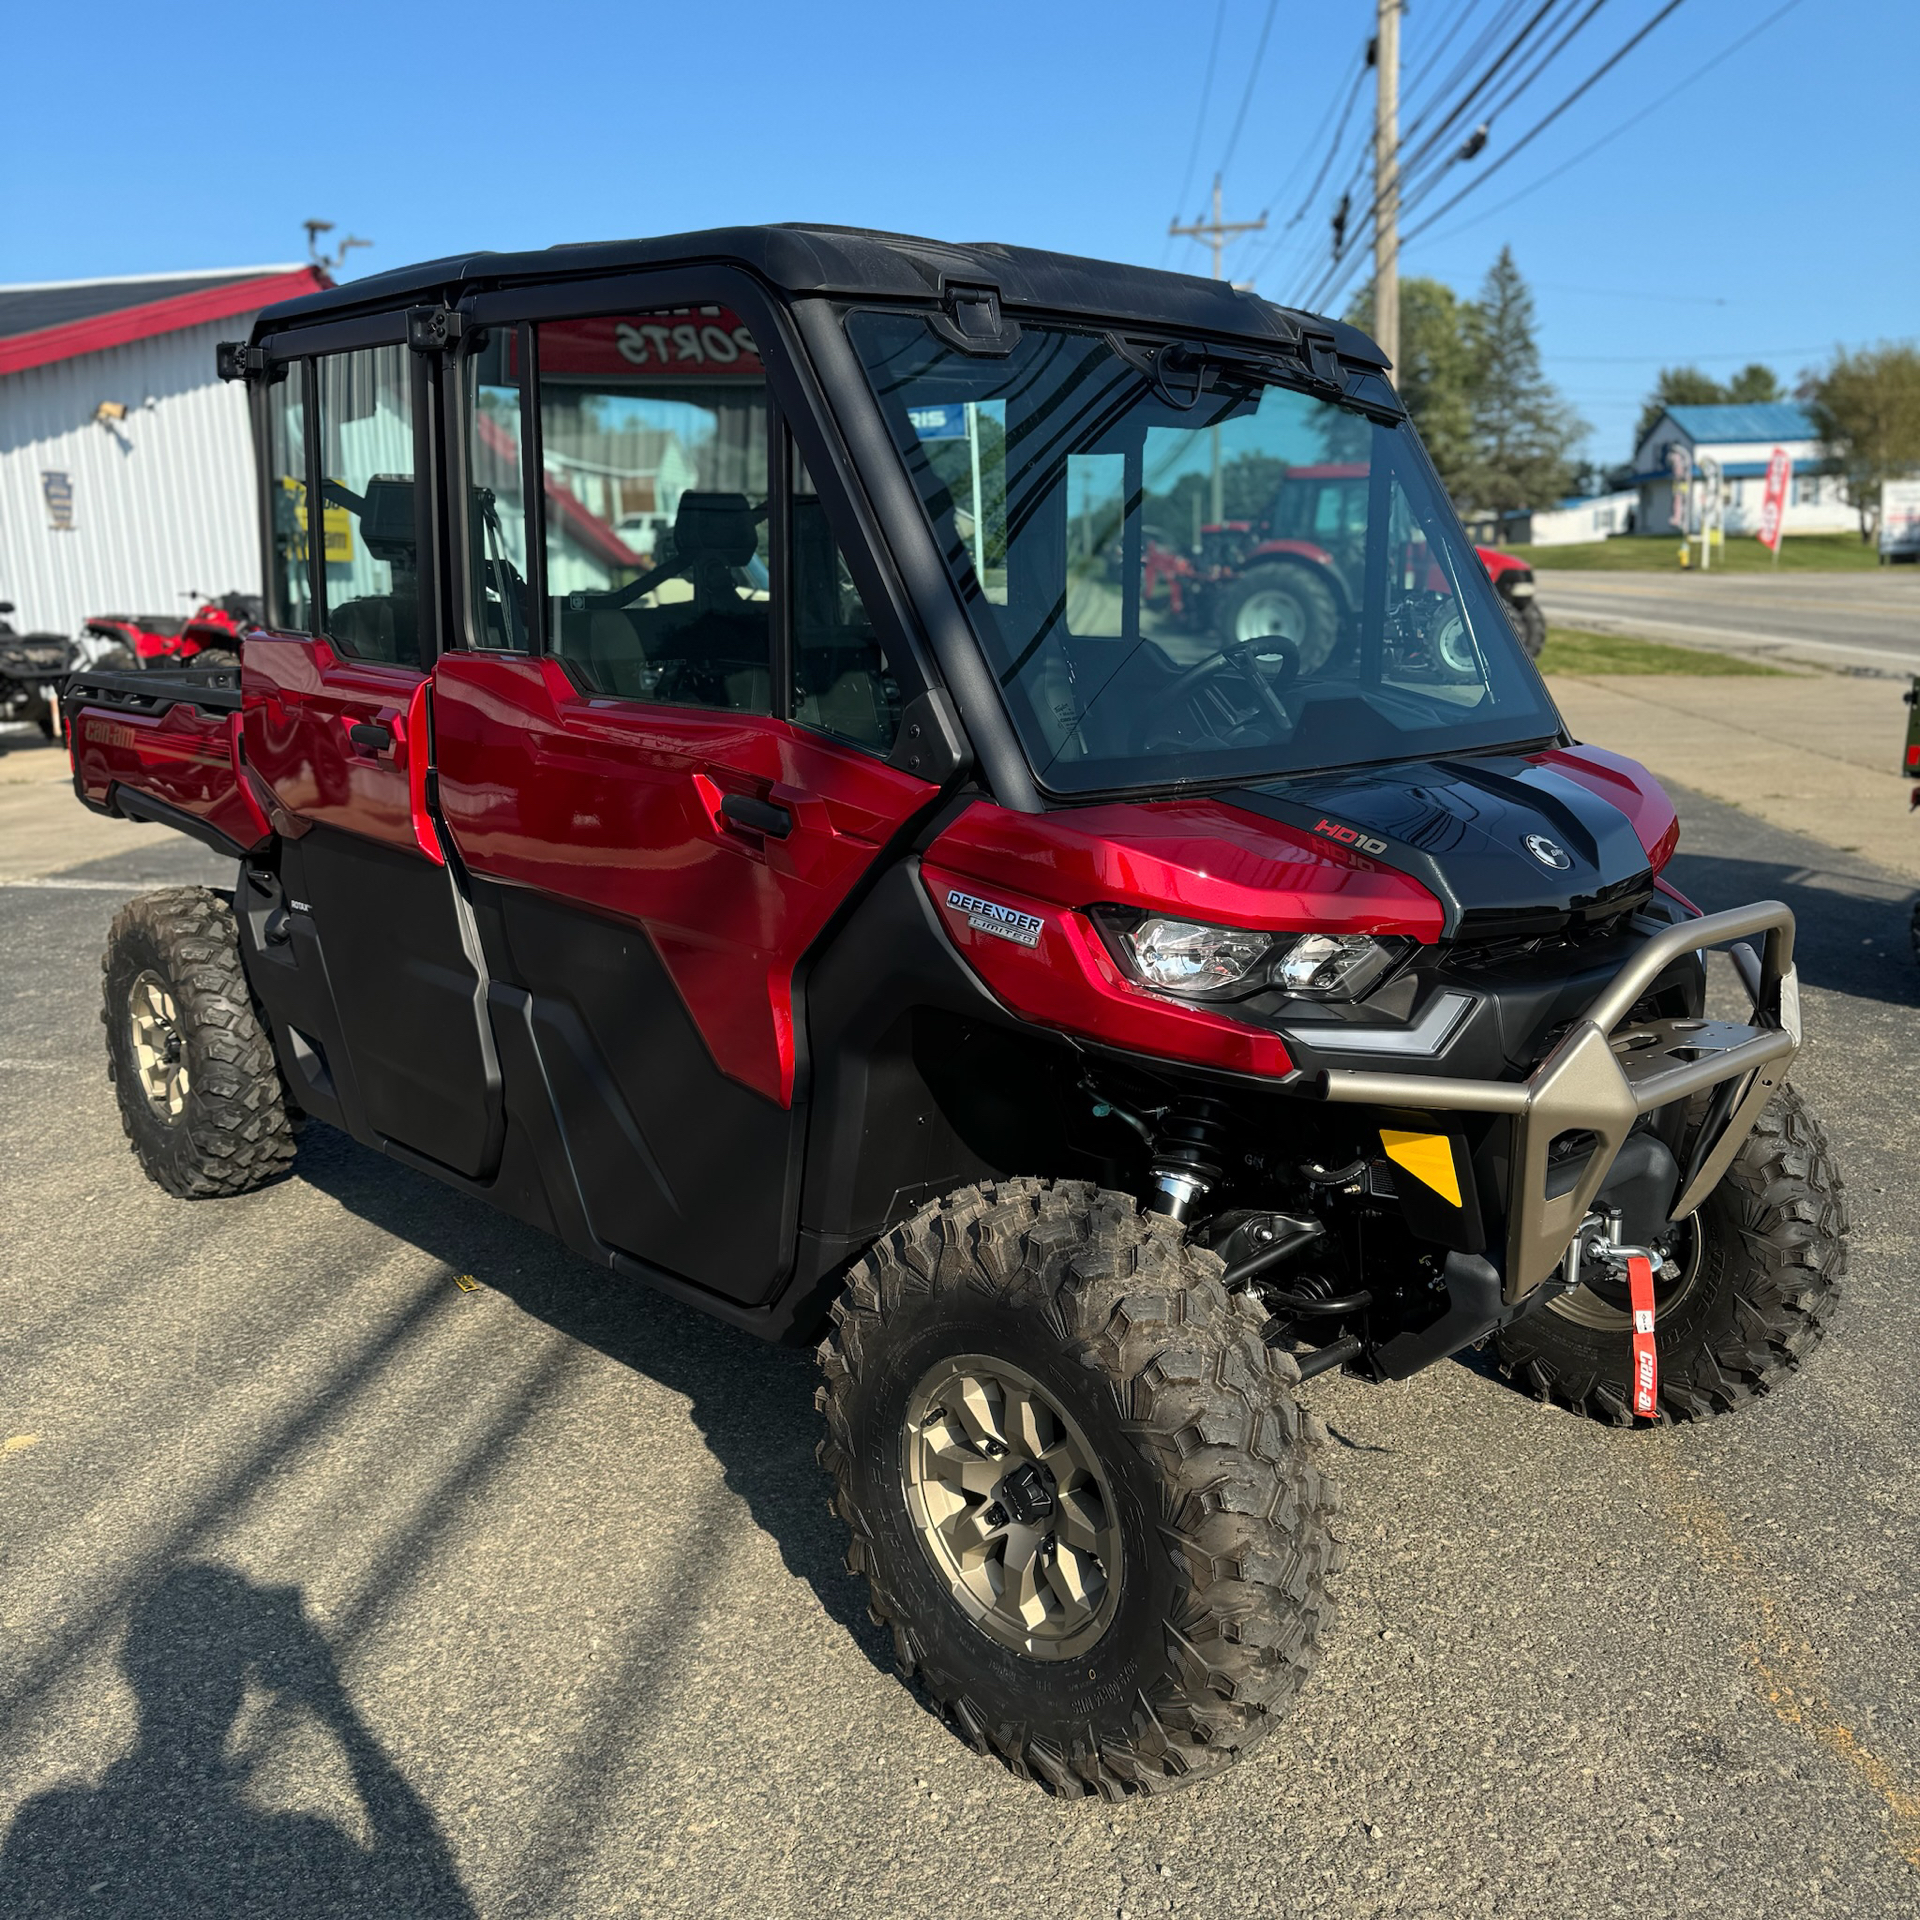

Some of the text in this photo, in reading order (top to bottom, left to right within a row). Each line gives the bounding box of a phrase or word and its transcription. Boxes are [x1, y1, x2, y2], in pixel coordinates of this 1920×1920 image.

[85, 719, 136, 750] can-am
[1314, 818, 1388, 855] HD10
[949, 892, 1040, 932] DEFENDER
[972, 919, 1032, 943] LIMITED
